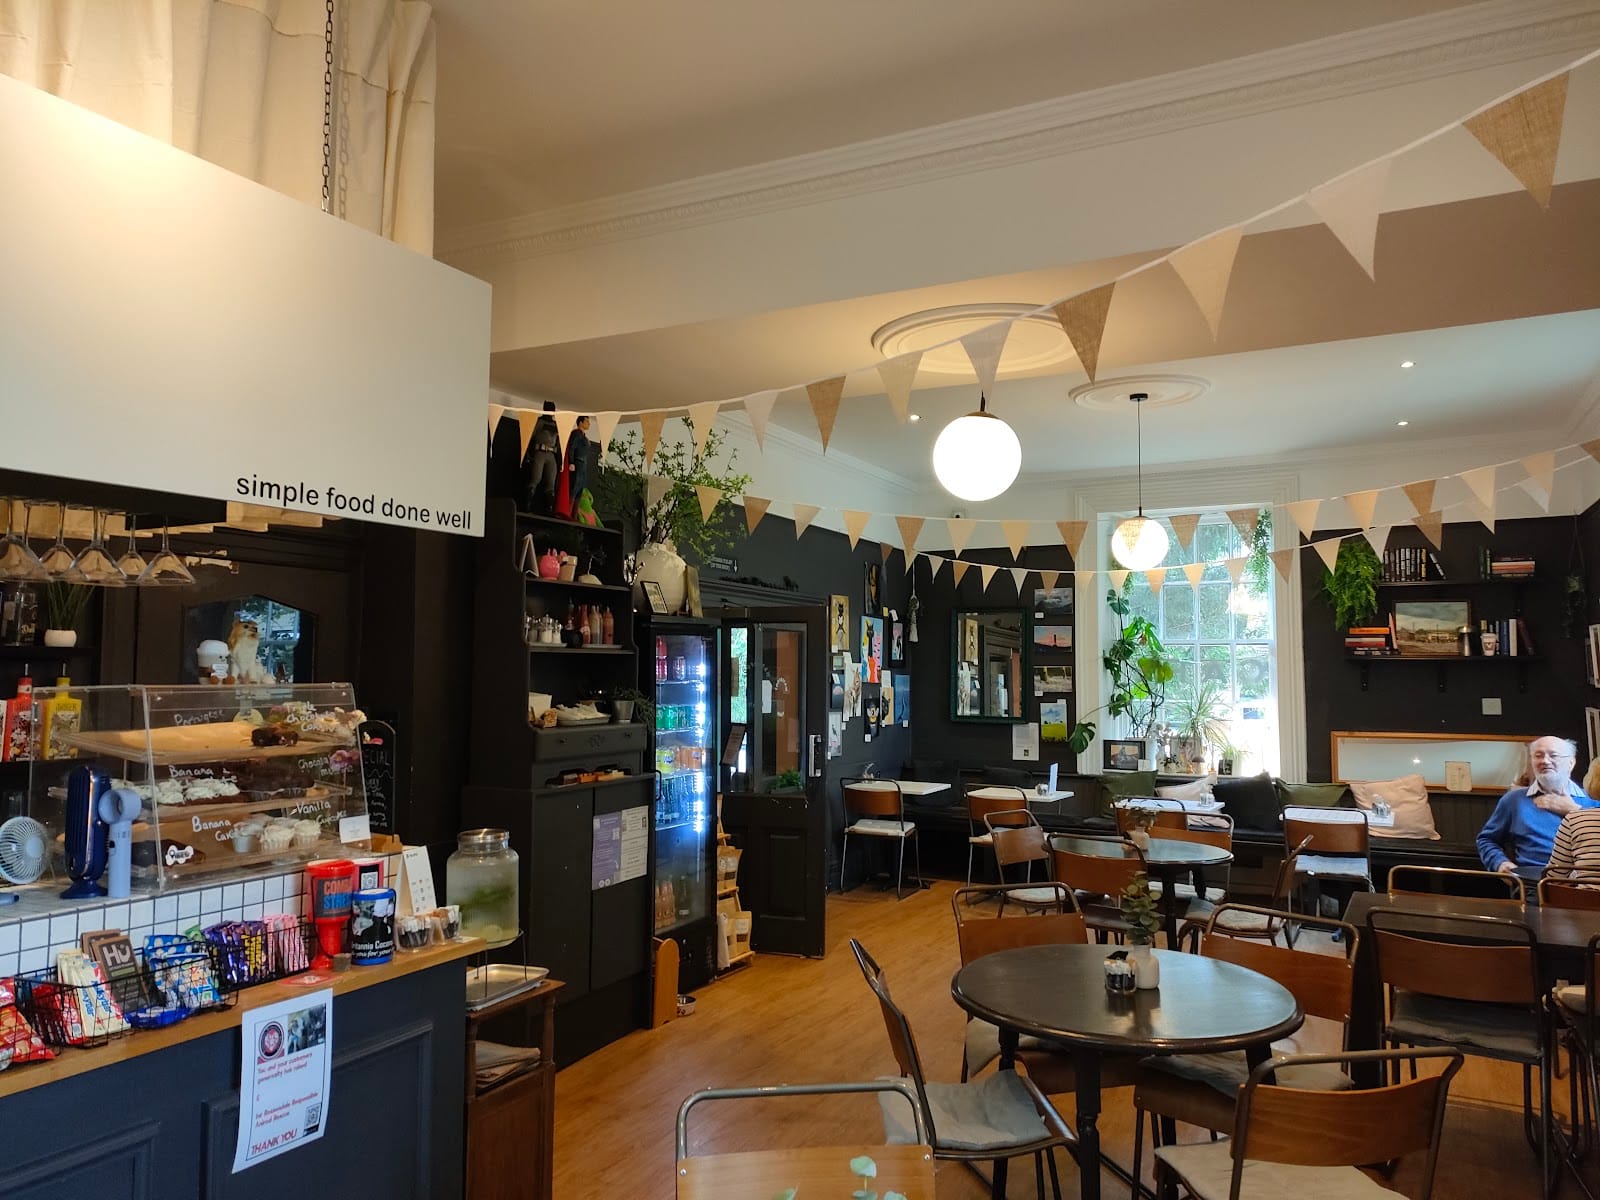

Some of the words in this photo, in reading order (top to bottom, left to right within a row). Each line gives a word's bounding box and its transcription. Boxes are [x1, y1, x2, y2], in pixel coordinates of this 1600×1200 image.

[236, 473, 320, 507] simple
[326, 487, 374, 515] food
[381, 497, 430, 523] done
[436, 510, 471, 530] well
[168, 764, 215, 779] Banana
[296, 800, 332, 815] Vanilla
[191, 815, 232, 833] Banana
[251, 1137, 280, 1156] THANK
[281, 1128, 298, 1141] YOU
